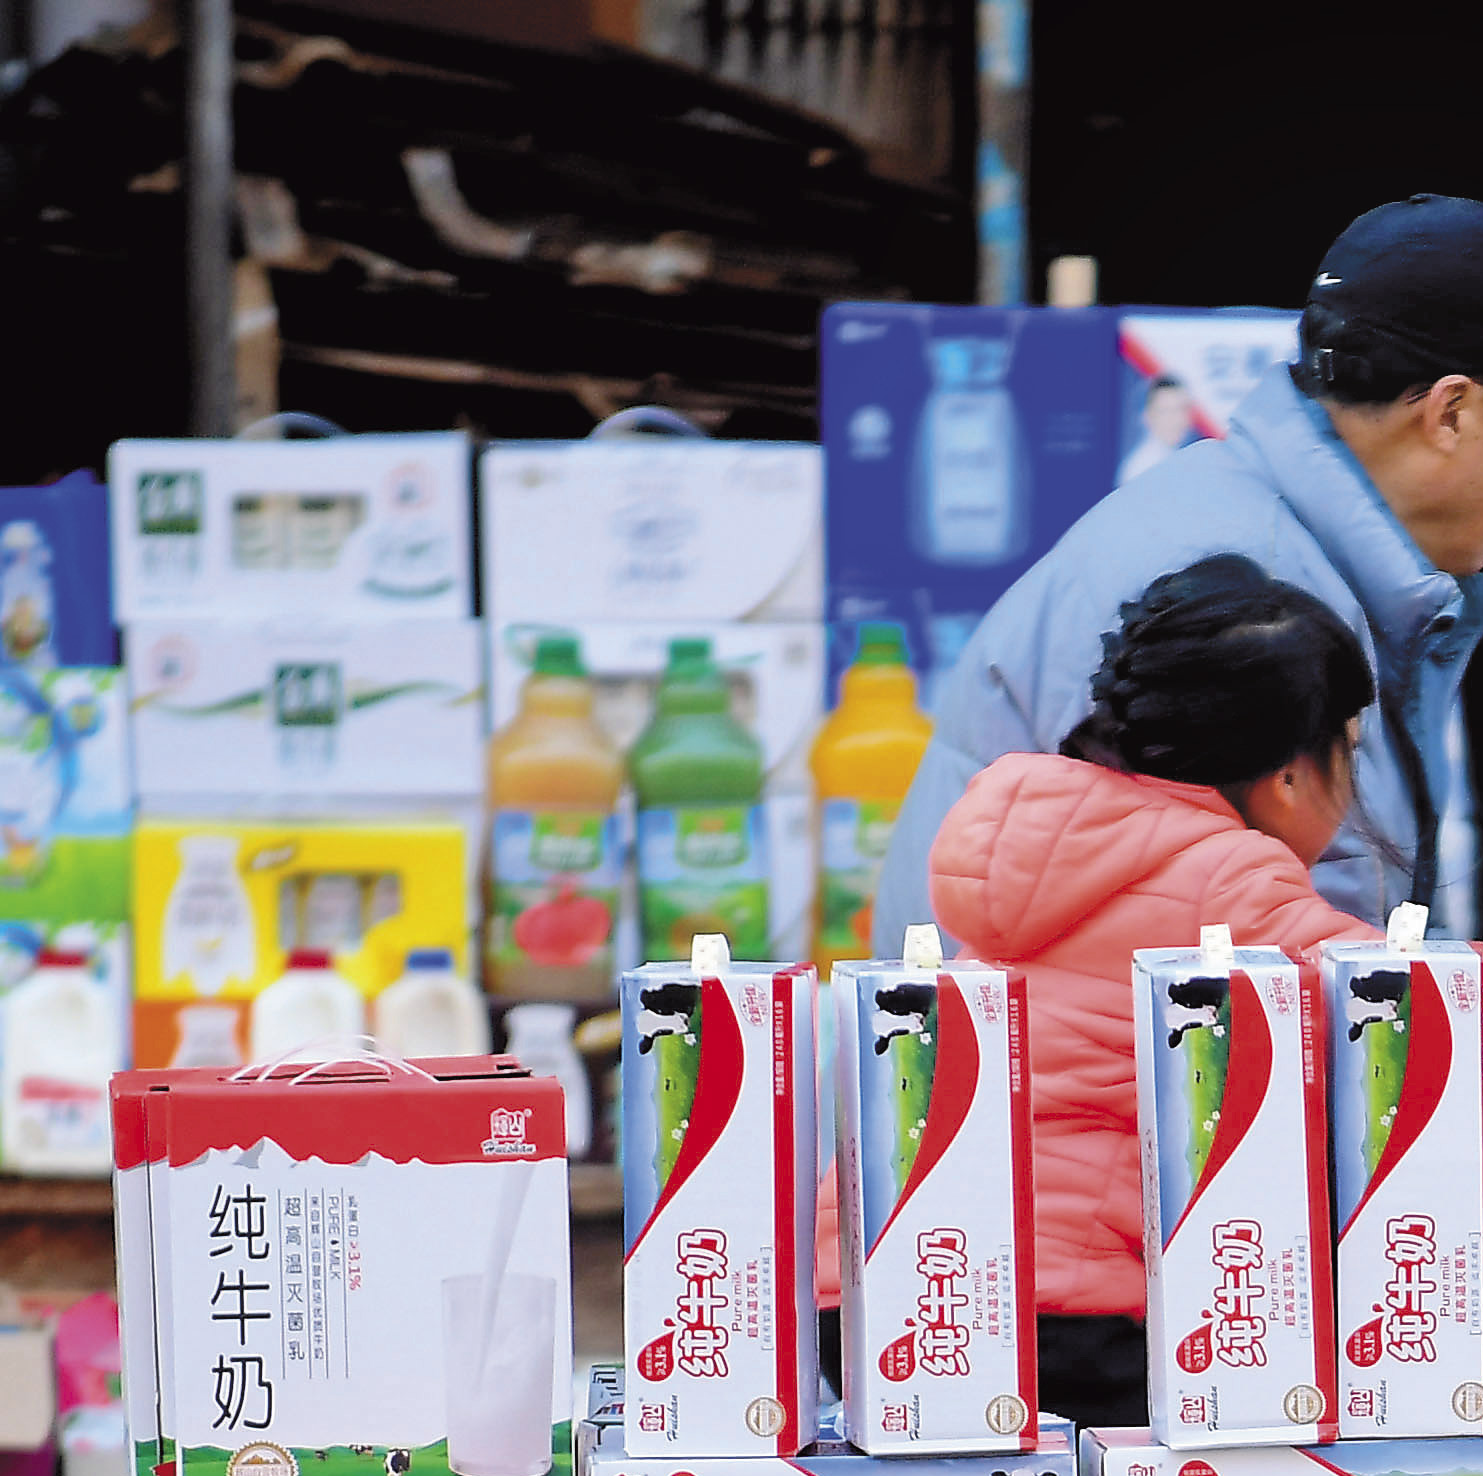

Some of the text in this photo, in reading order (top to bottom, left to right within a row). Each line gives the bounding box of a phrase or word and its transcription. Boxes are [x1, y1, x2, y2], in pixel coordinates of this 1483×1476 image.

[207, 1184, 272, 1430] 纯牛奶
[284, 1196, 305, 1361] 超高温灭菌乳
[677, 1229, 729, 1378] 纯牛奶
[916, 1228, 970, 1377] 纯牛奶
[1212, 1219, 1267, 1367] 纯牛奶
[1385, 1214, 1437, 1363] 纯牛奶
